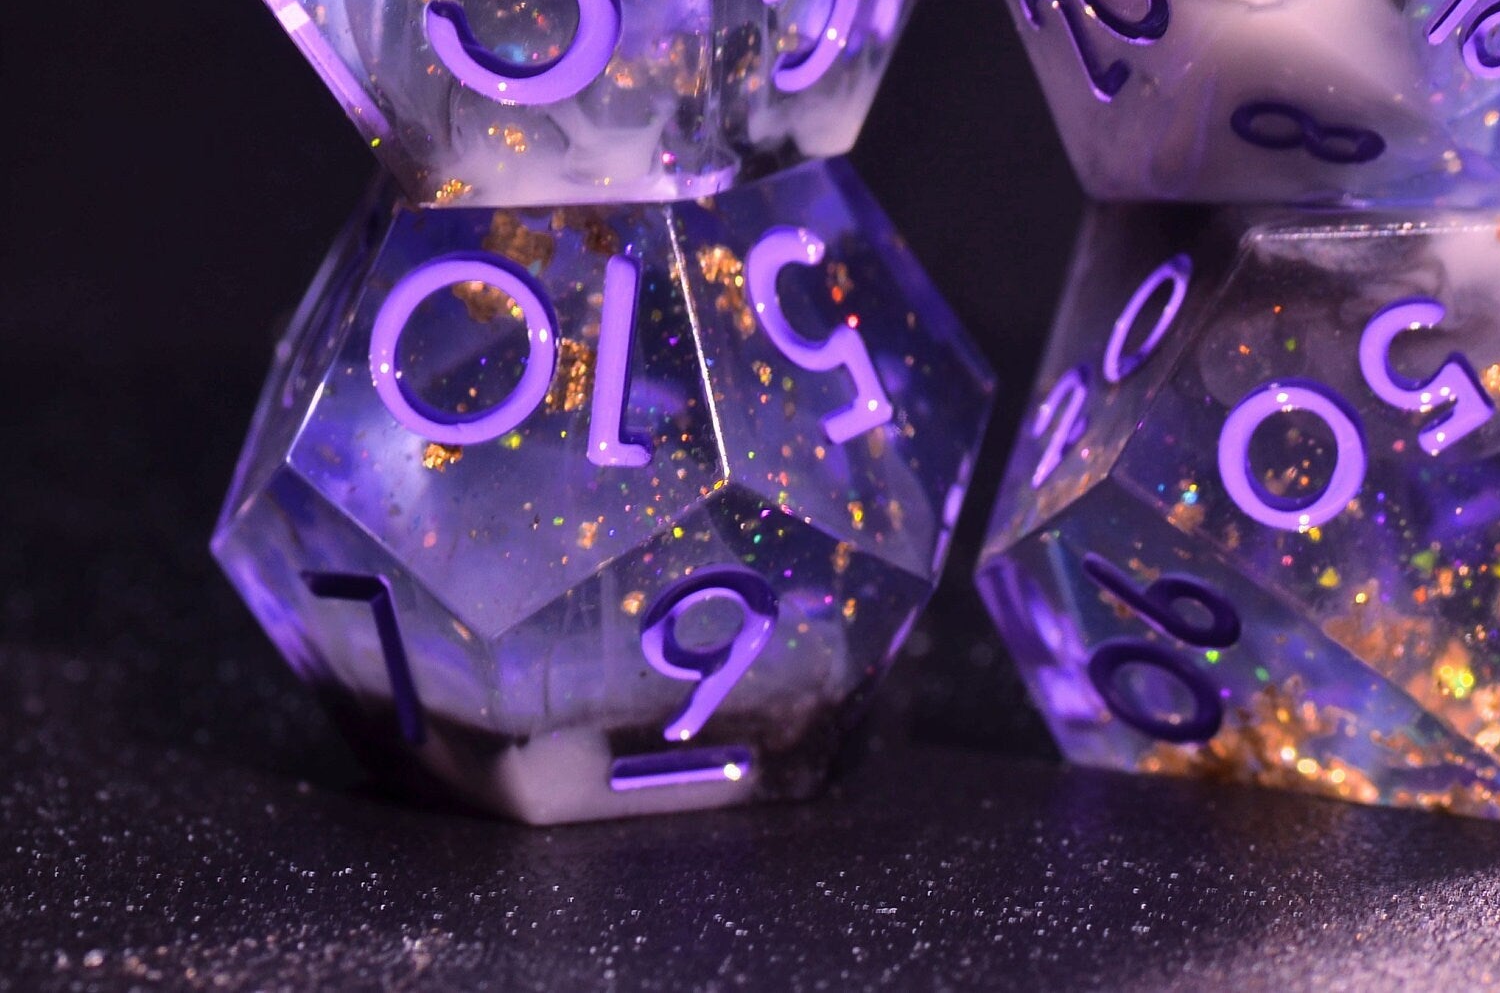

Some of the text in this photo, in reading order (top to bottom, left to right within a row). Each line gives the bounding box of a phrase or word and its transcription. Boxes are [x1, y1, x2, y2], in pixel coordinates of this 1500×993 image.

[1229, 99, 1386, 165] 8
[368, 250, 653, 468] 10
[745, 225, 893, 444] 5
[1030, 254, 1194, 488] 20
[1218, 296, 1494, 532] 50
[299, 570, 429, 746] 7
